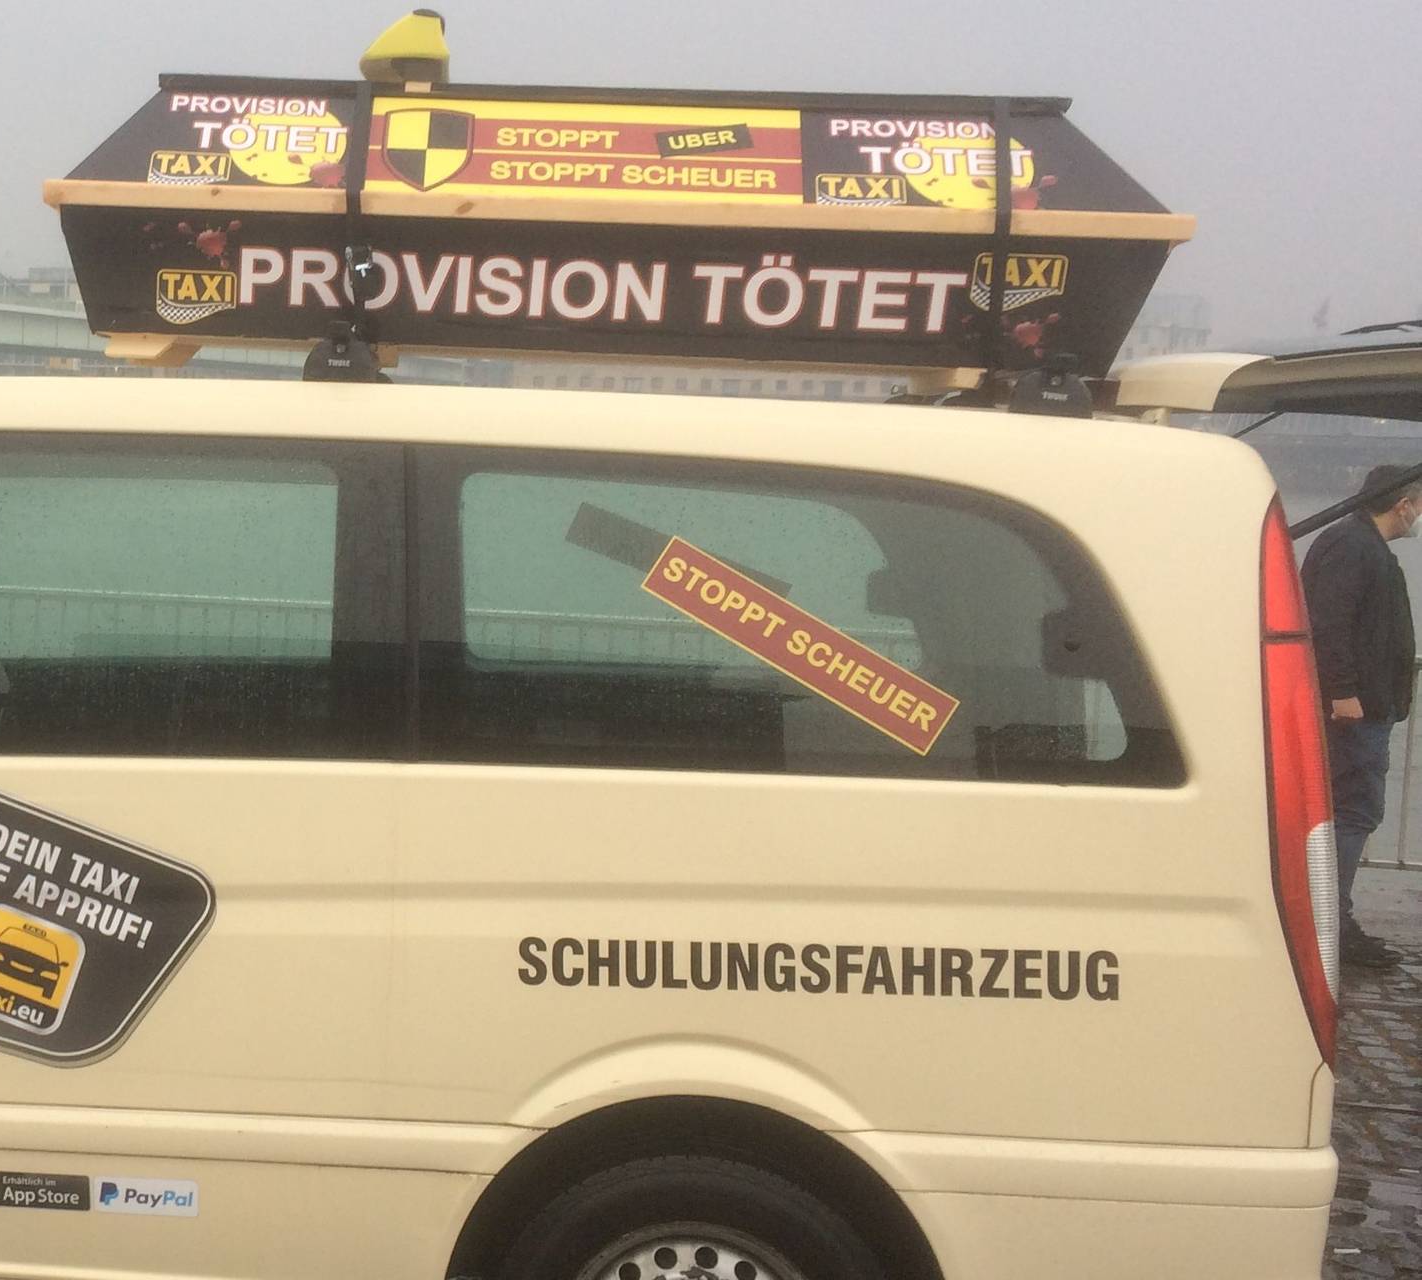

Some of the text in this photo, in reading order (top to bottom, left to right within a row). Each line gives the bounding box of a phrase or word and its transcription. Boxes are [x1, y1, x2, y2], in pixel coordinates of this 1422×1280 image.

[170, 94, 327, 117] PROVISION
[193, 118, 348, 154] TÖTET
[496, 126, 737, 150] STOPPT UBER
[830, 118, 997, 139] PROVISION
[156, 153, 227, 176] TAXI
[859, 142, 1033, 177] TÖTET
[489, 160, 777, 189] STOPPT SCHEUER
[821, 176, 900, 199] TAXI
[161, 273, 233, 303] TAXI
[239, 246, 968, 333] PROVISION TÖTET
[662, 556, 938, 732] STOPPT SCHEUER
[70, 854, 141, 906] TAXI
[13, 875, 154, 949] APPRUF!
[517, 936, 1120, 1002] SCHULUNGSFAHRZEUG
[2, 1187, 80, 1206] App Store
[124, 1188, 194, 1209] PayPal
